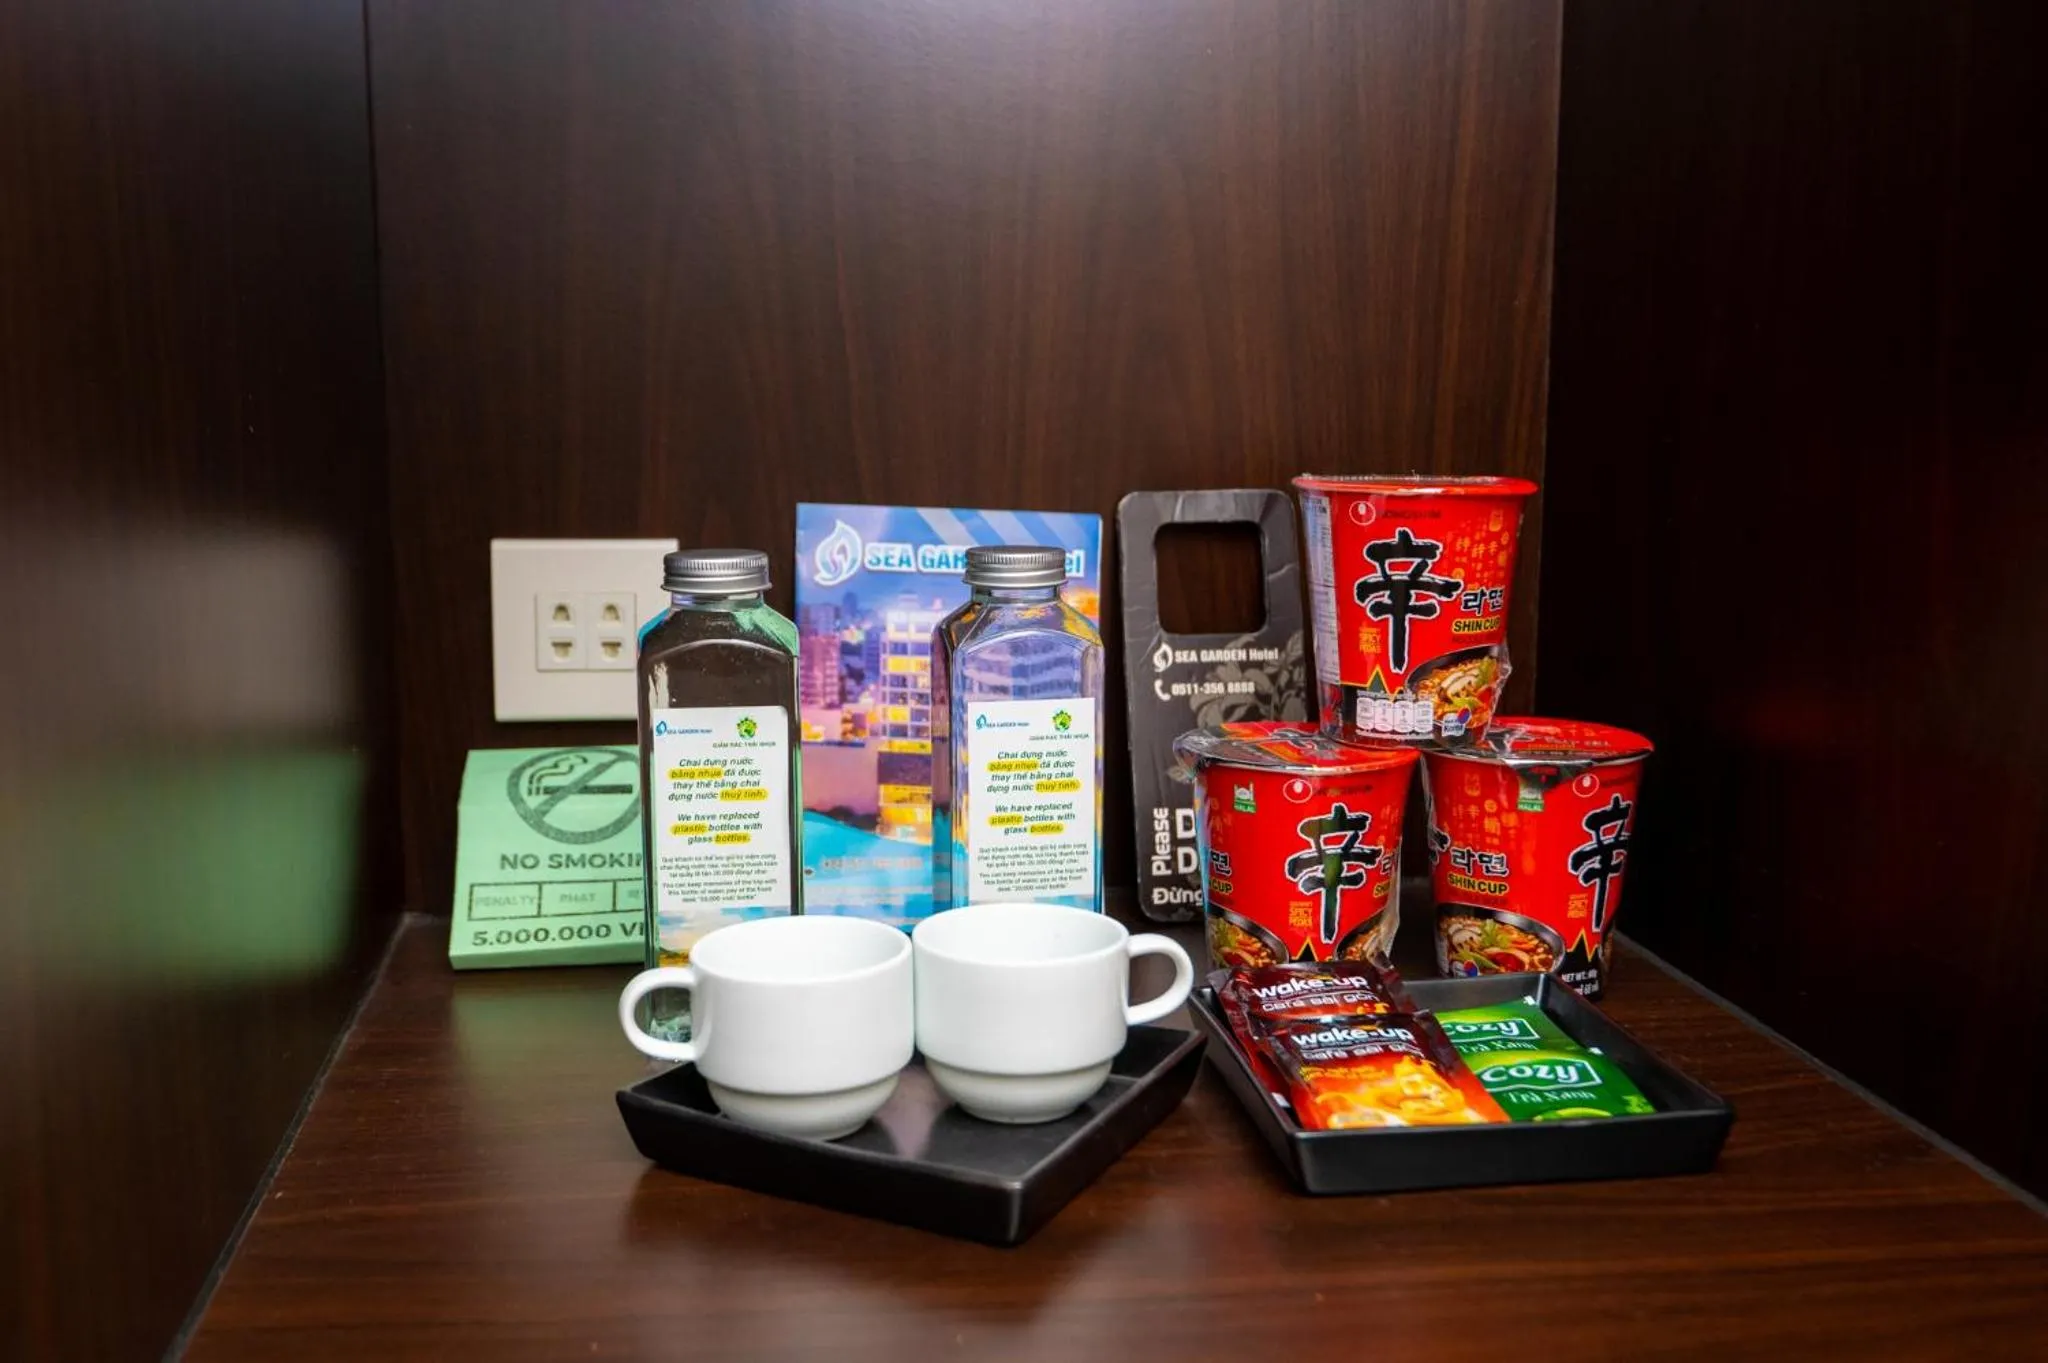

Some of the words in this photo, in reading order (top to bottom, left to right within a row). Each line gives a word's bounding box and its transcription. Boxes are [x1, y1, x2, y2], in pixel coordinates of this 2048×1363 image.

[866, 549, 914, 570] SEA
[920, 550, 967, 571] GAR
[1354, 527, 1464, 673] 辛
[1174, 649, 1198, 663] SEA
[1200, 648, 1247, 662] GARDEN
[1249, 648, 1279, 661] Hotel
[679, 758, 701, 767] Chai
[997, 751, 1019, 760] Chai
[991, 773, 1011, 782] thay
[1054, 770, 1074, 778] chai
[673, 781, 693, 790] thay
[740, 779, 760, 787] chai
[995, 804, 1008, 813] We
[1010, 804, 1032, 812] have
[1034, 802, 1073, 812] replaced
[678, 812, 692, 821] We
[694, 812, 717, 821] have
[719, 811, 760, 821] replaced
[991, 815, 1023, 825] plastic
[1024, 814, 1055, 822] bottles
[1057, 813, 1075, 821] with
[1175, 808, 1196, 839] D
[673, 823, 706, 835] plastic
[708, 823, 740, 832] bottles
[744, 822, 763, 831] with
[1004, 826, 1027, 835] glass
[1030, 824, 1063, 833] bottles.
[688, 835, 713, 845] glass
[715, 834, 750, 843] bottles.
[1151, 808, 1172, 876] Please
[500, 853, 541, 870] NO
[548, 852, 643, 870] SMOKI
[1211, 850, 1232, 876] 면
[1450, 847, 1509, 877] 라면
[1285, 802, 1385, 944] 辛
[475, 895, 537, 907] PENALTY
[472, 924, 612, 946] 5.000.000
[1252, 974, 1370, 998] wake-up
[1290, 1027, 1418, 1046] wake-up
[1480, 1062, 1580, 1083] Cozy
[1549, 1089, 1597, 1101] Xanh
